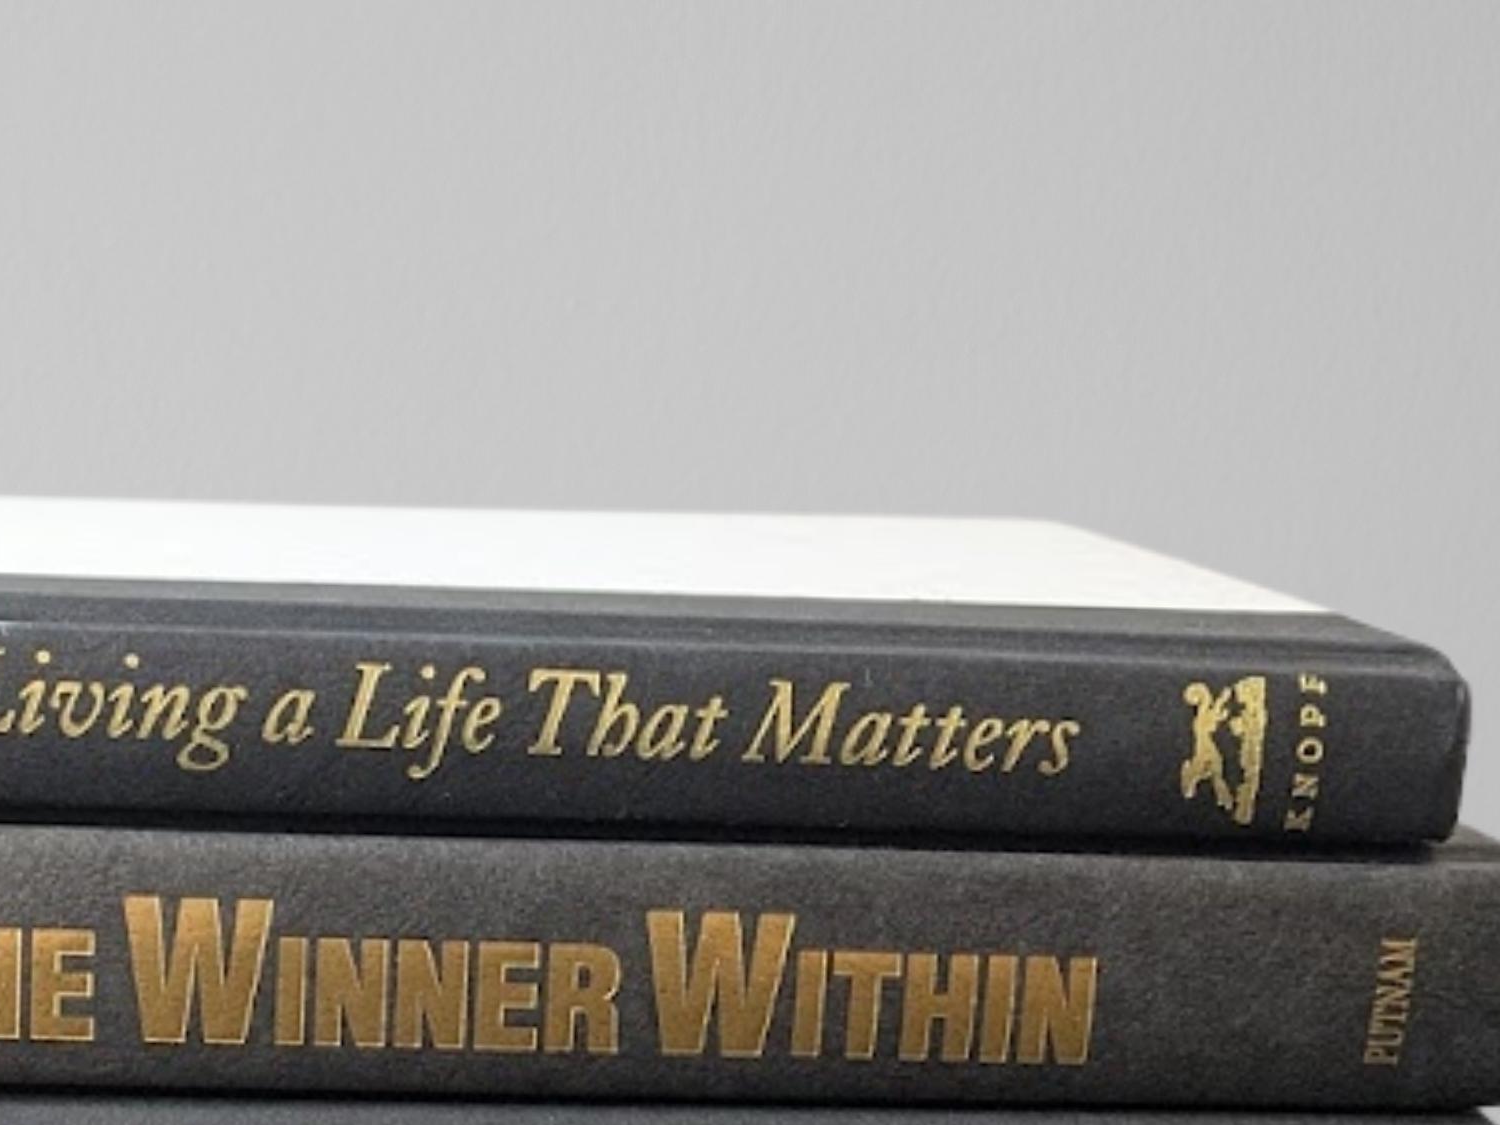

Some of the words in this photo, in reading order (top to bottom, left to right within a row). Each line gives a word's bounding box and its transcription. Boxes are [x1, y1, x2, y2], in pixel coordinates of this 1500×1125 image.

[262, 685, 316, 746] a
[336, 660, 504, 780] Life
[524, 668, 732, 762] That
[740, 678, 1084, 776] Matters
[1282, 672, 1328, 832] KNOPF
[1363, 935, 1418, 1066] PUTNAM
